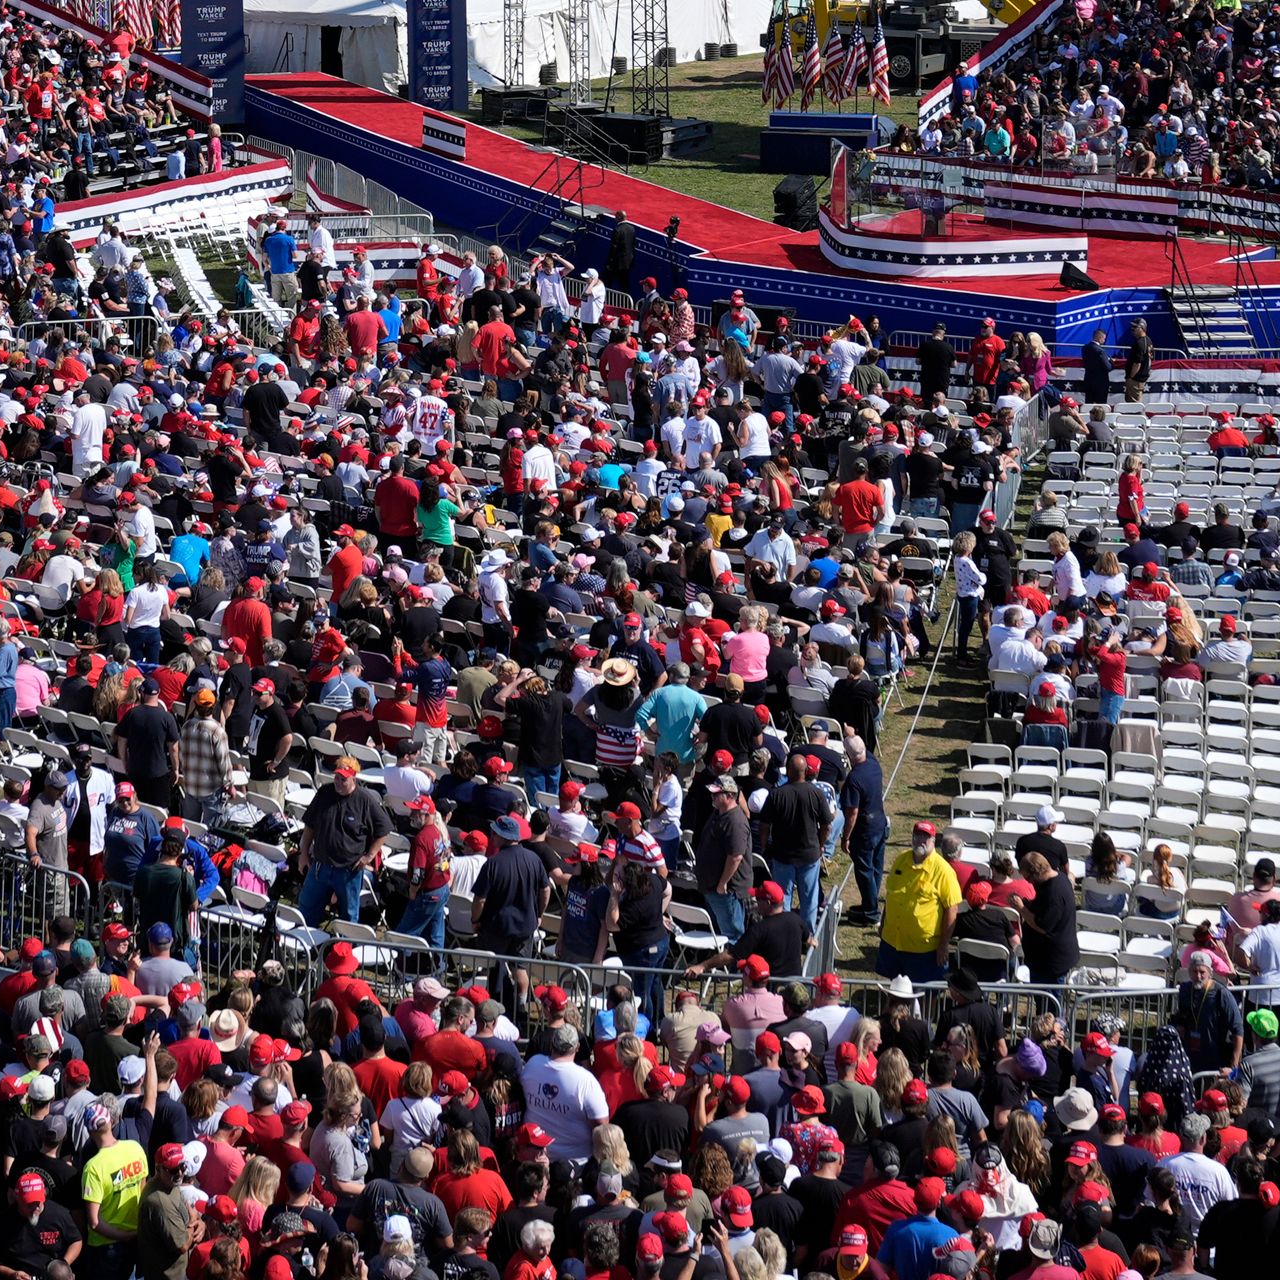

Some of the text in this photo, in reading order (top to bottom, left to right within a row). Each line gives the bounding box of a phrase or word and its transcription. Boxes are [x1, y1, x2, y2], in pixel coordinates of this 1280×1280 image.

[196, 6, 227, 15] TRUMP
[197, 52, 228, 61] TRUMP
[423, 86, 452, 94] TRUMP
[419, 412, 438, 431] 47
[657, 478, 681, 499] 26
[247, 545, 271, 556] TRUMP
[246, 556, 269, 564] VANCE
[527, 1092, 570, 1115] TRUMP
